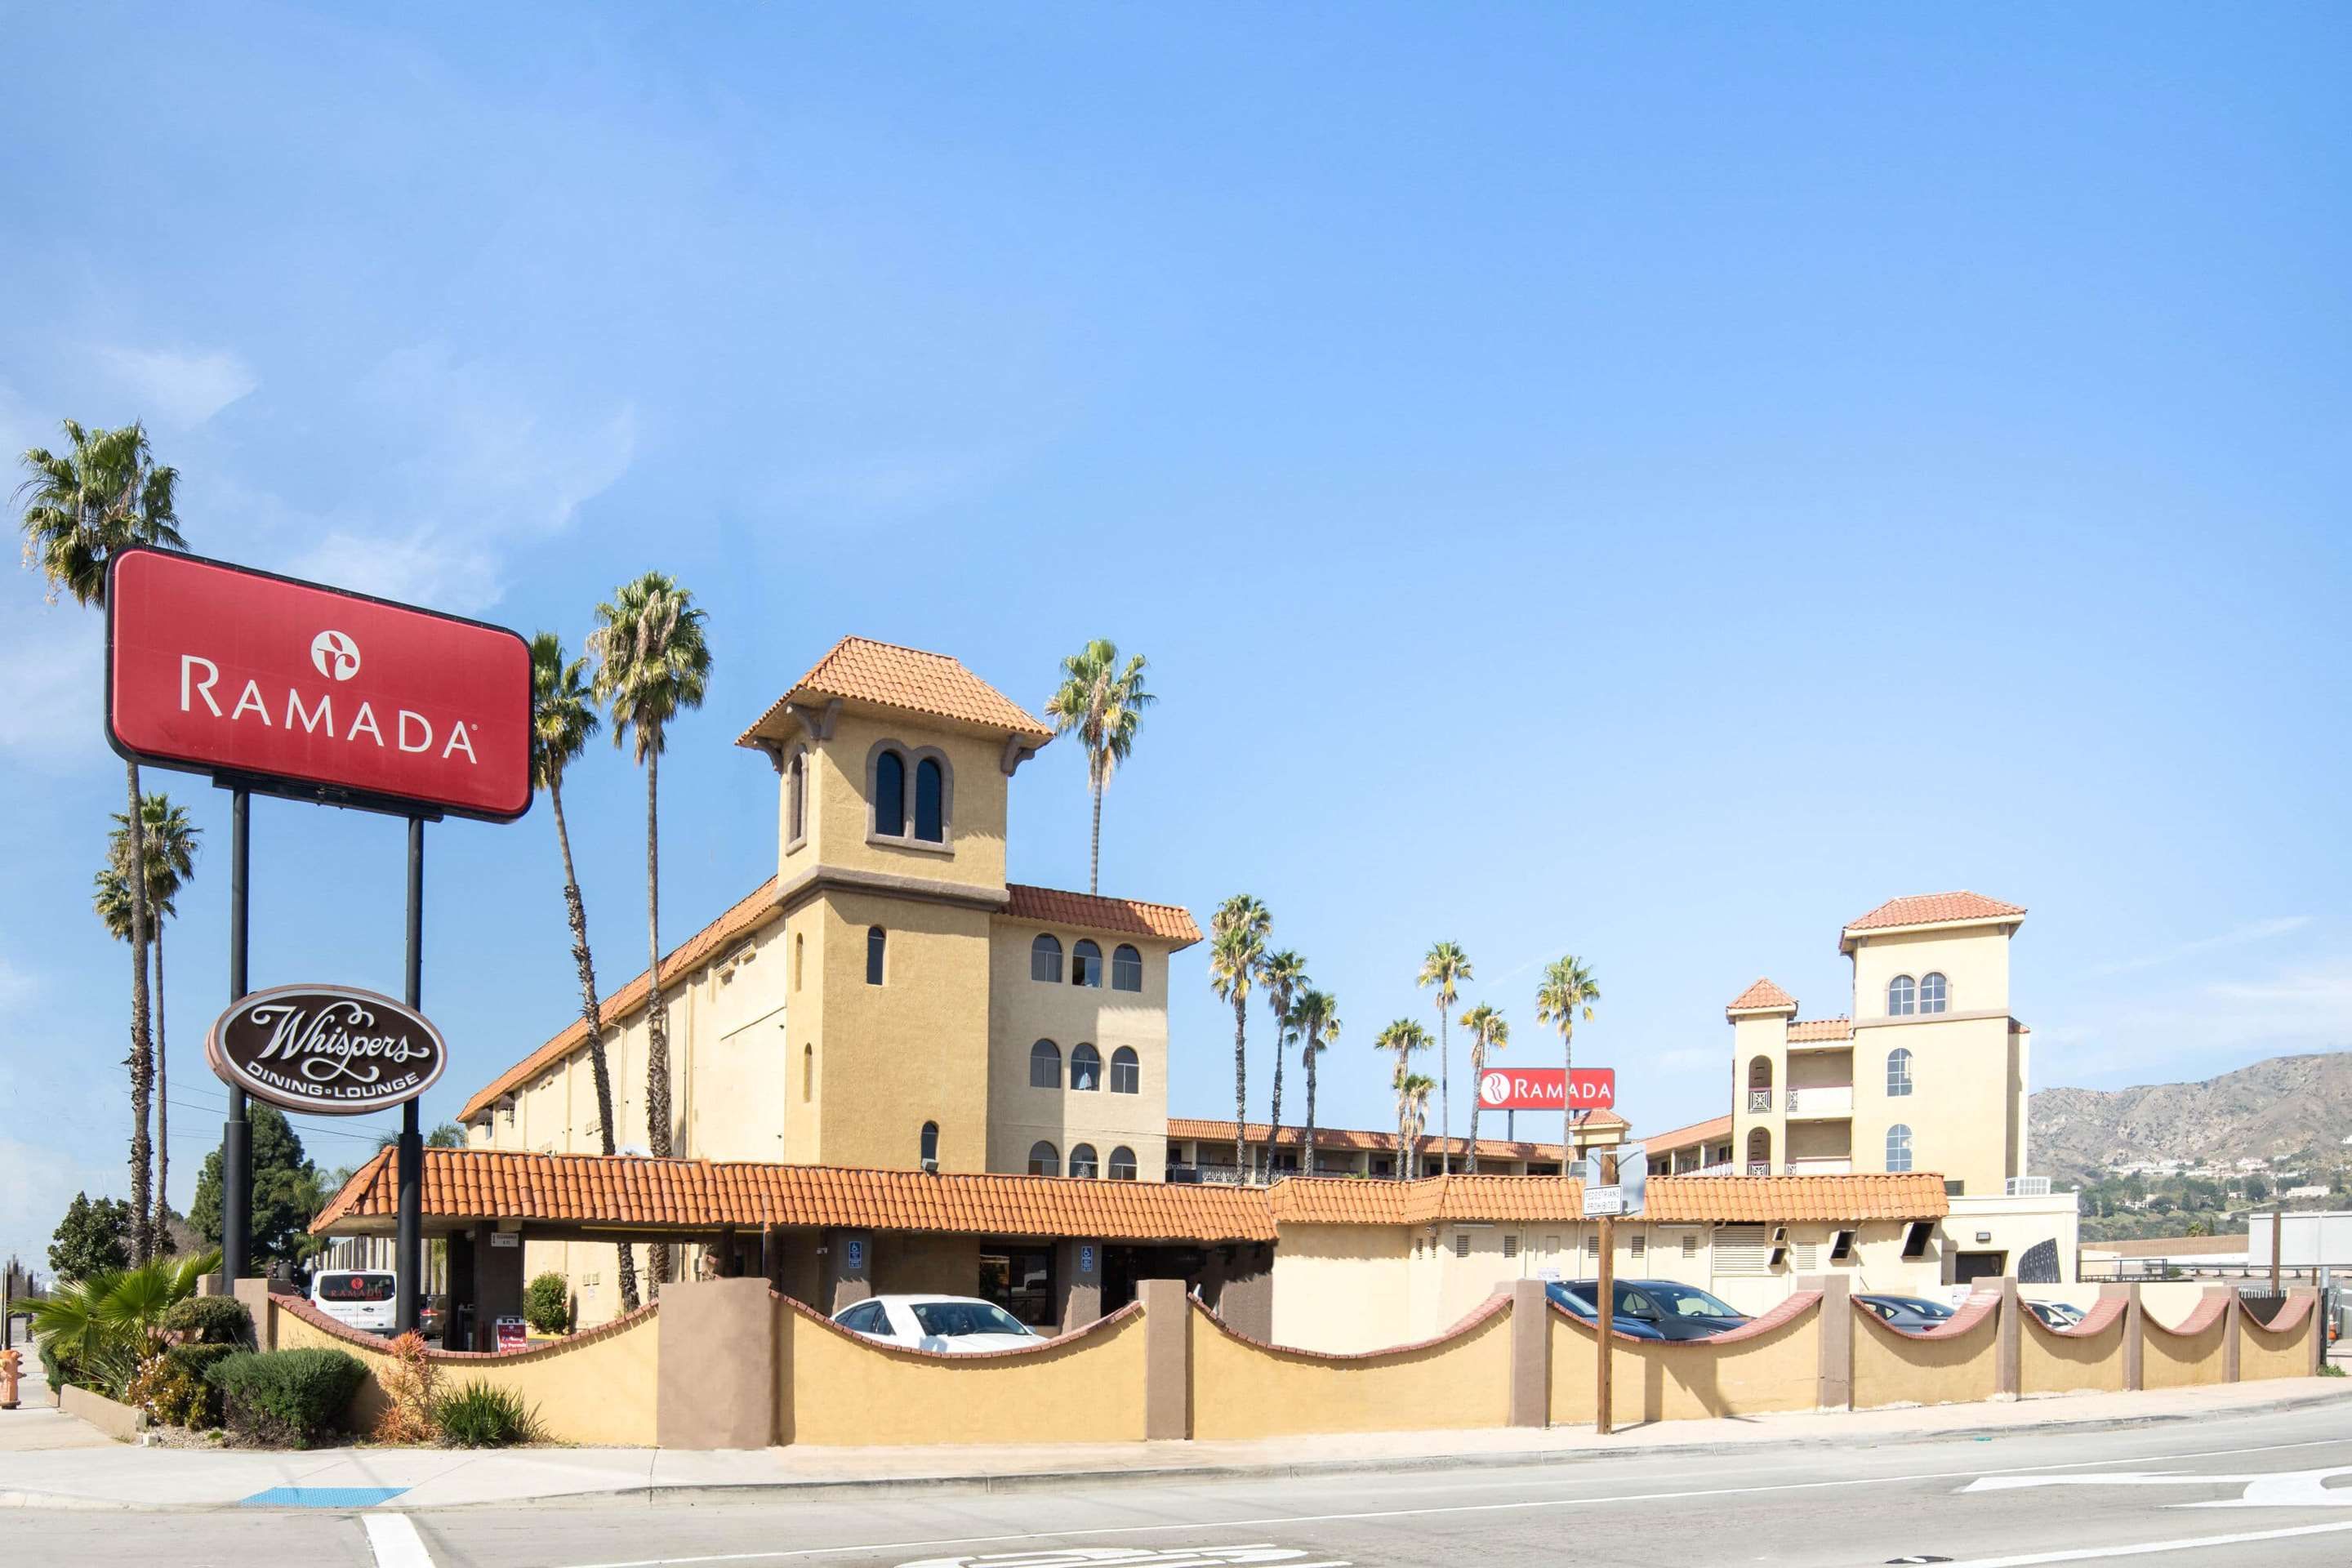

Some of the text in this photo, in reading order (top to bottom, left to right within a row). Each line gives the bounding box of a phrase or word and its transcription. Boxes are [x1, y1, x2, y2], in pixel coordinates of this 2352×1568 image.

[181, 654, 477, 764] RAMADA
[251, 1001, 430, 1082] Whispers
[246, 1062, 420, 1098] DINING LOUNGE
[1515, 1079, 1611, 1098] RAMADA
